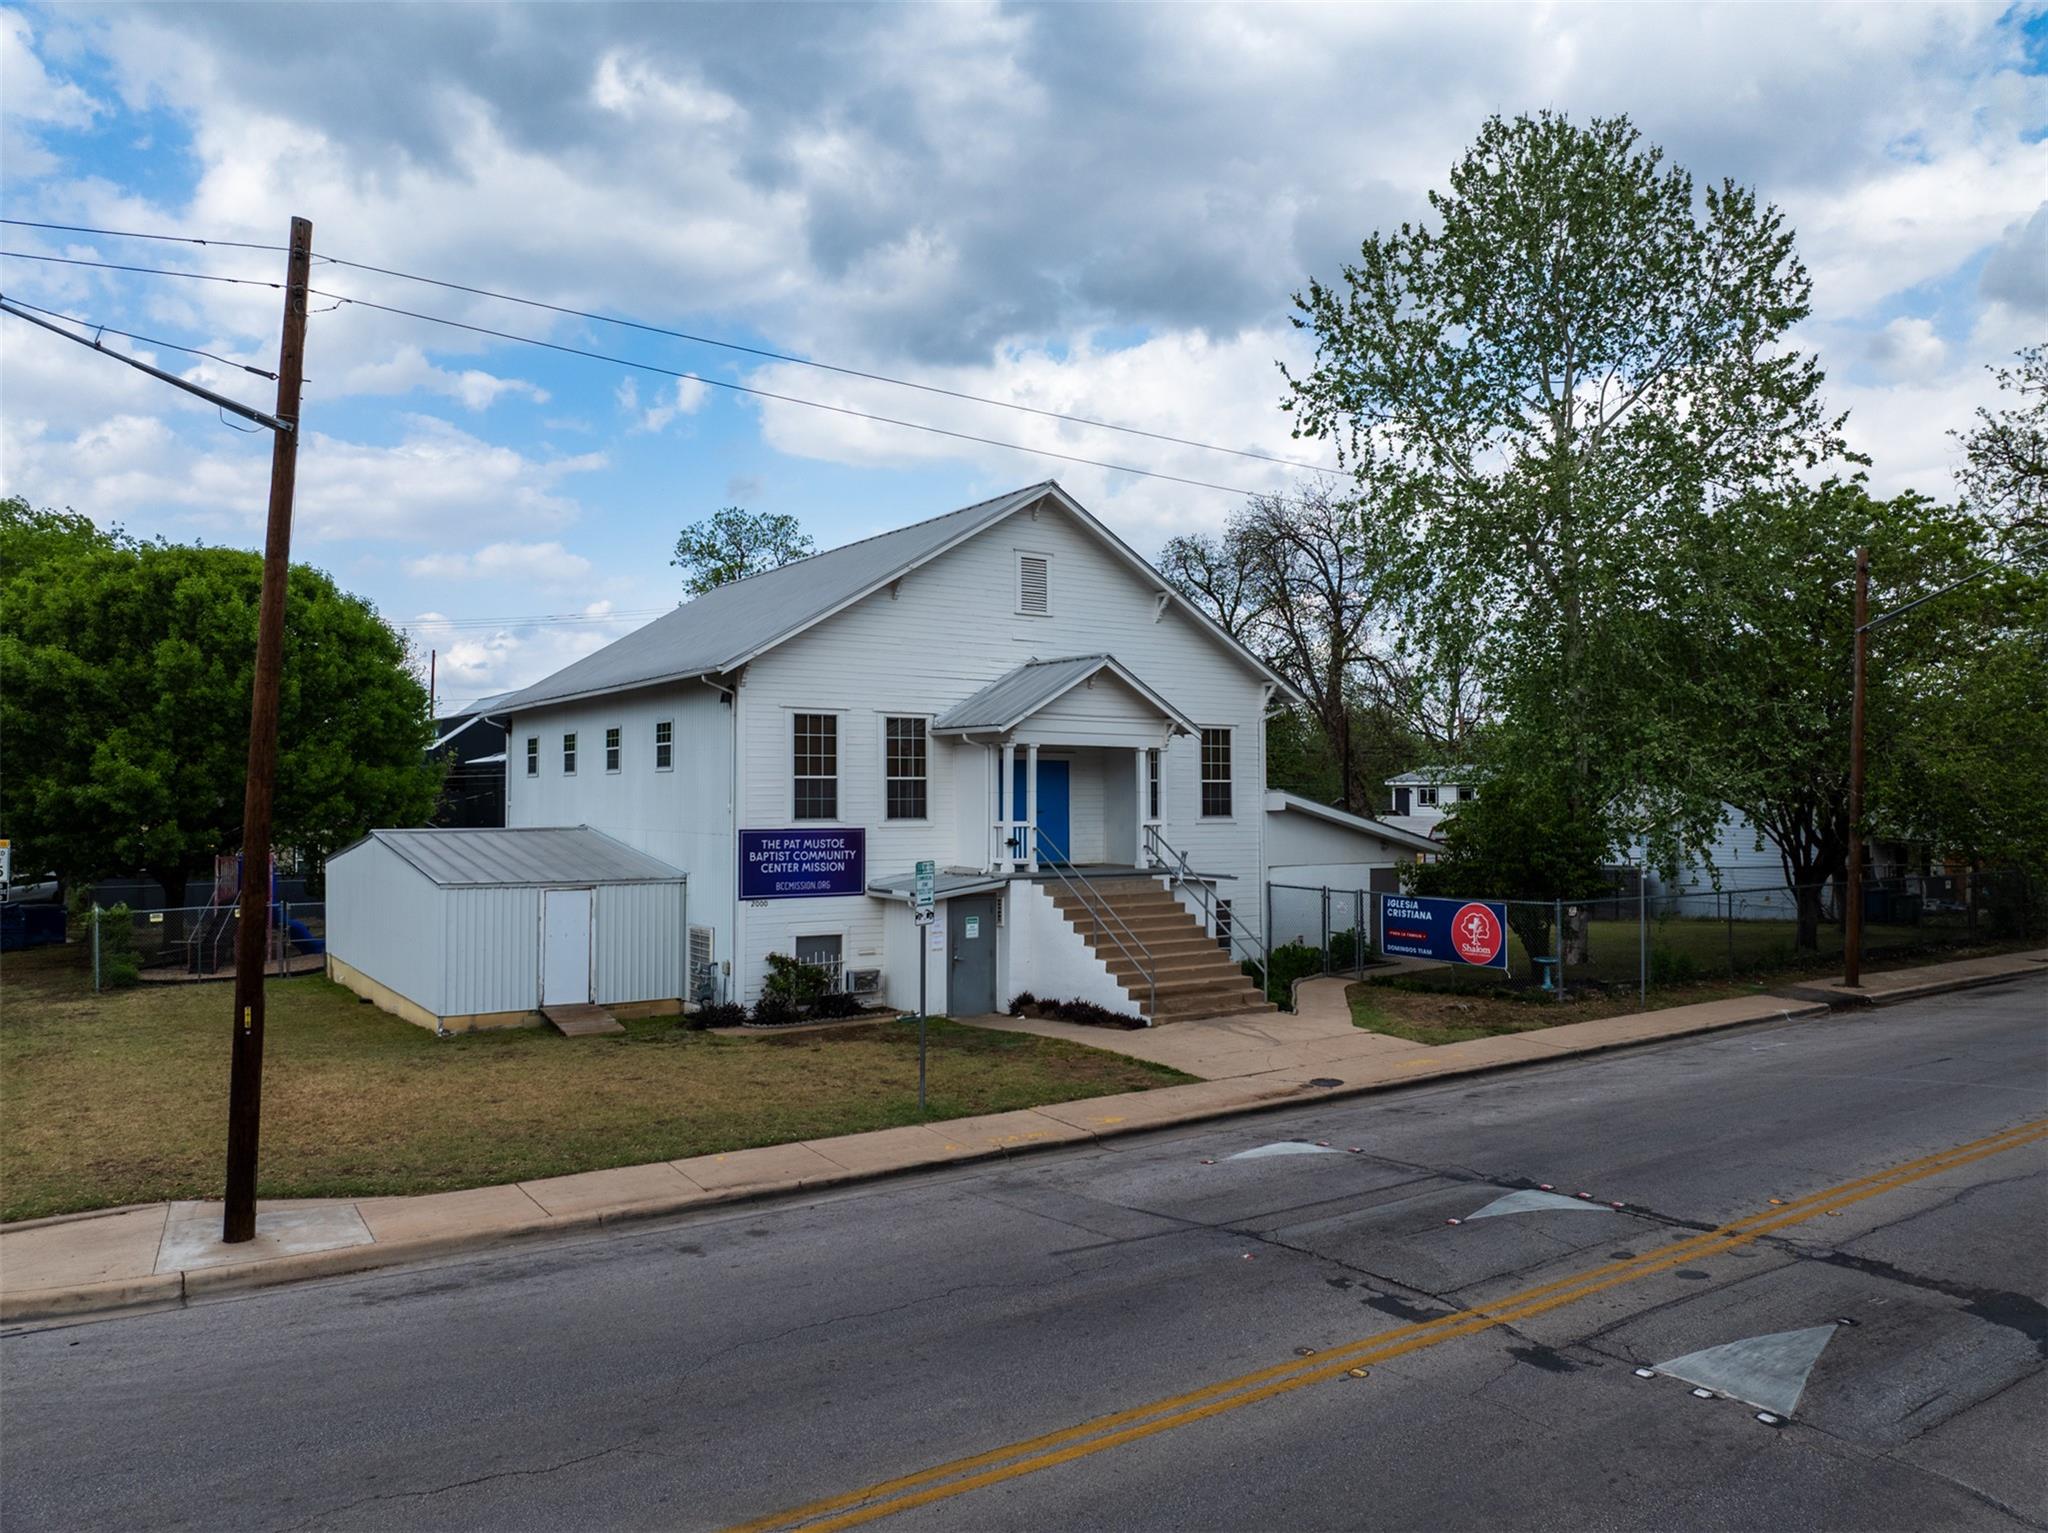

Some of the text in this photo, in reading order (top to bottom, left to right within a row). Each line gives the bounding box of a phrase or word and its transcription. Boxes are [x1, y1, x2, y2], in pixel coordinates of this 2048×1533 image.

[761, 838, 845, 850] THE PAT MUSTOE
[749, 850, 857, 862] BAPTIST COMMUNITY
[760, 862, 845, 873] CENTER MISSION
[775, 880, 831, 891] BCCMISSION.ORG
[1387, 898, 1419, 909] IGLESIA
[1387, 908, 1432, 920] CRISTIANA
[1387, 944, 1417, 953] DOMINGOS
[1462, 942, 1491, 954] Shalom
